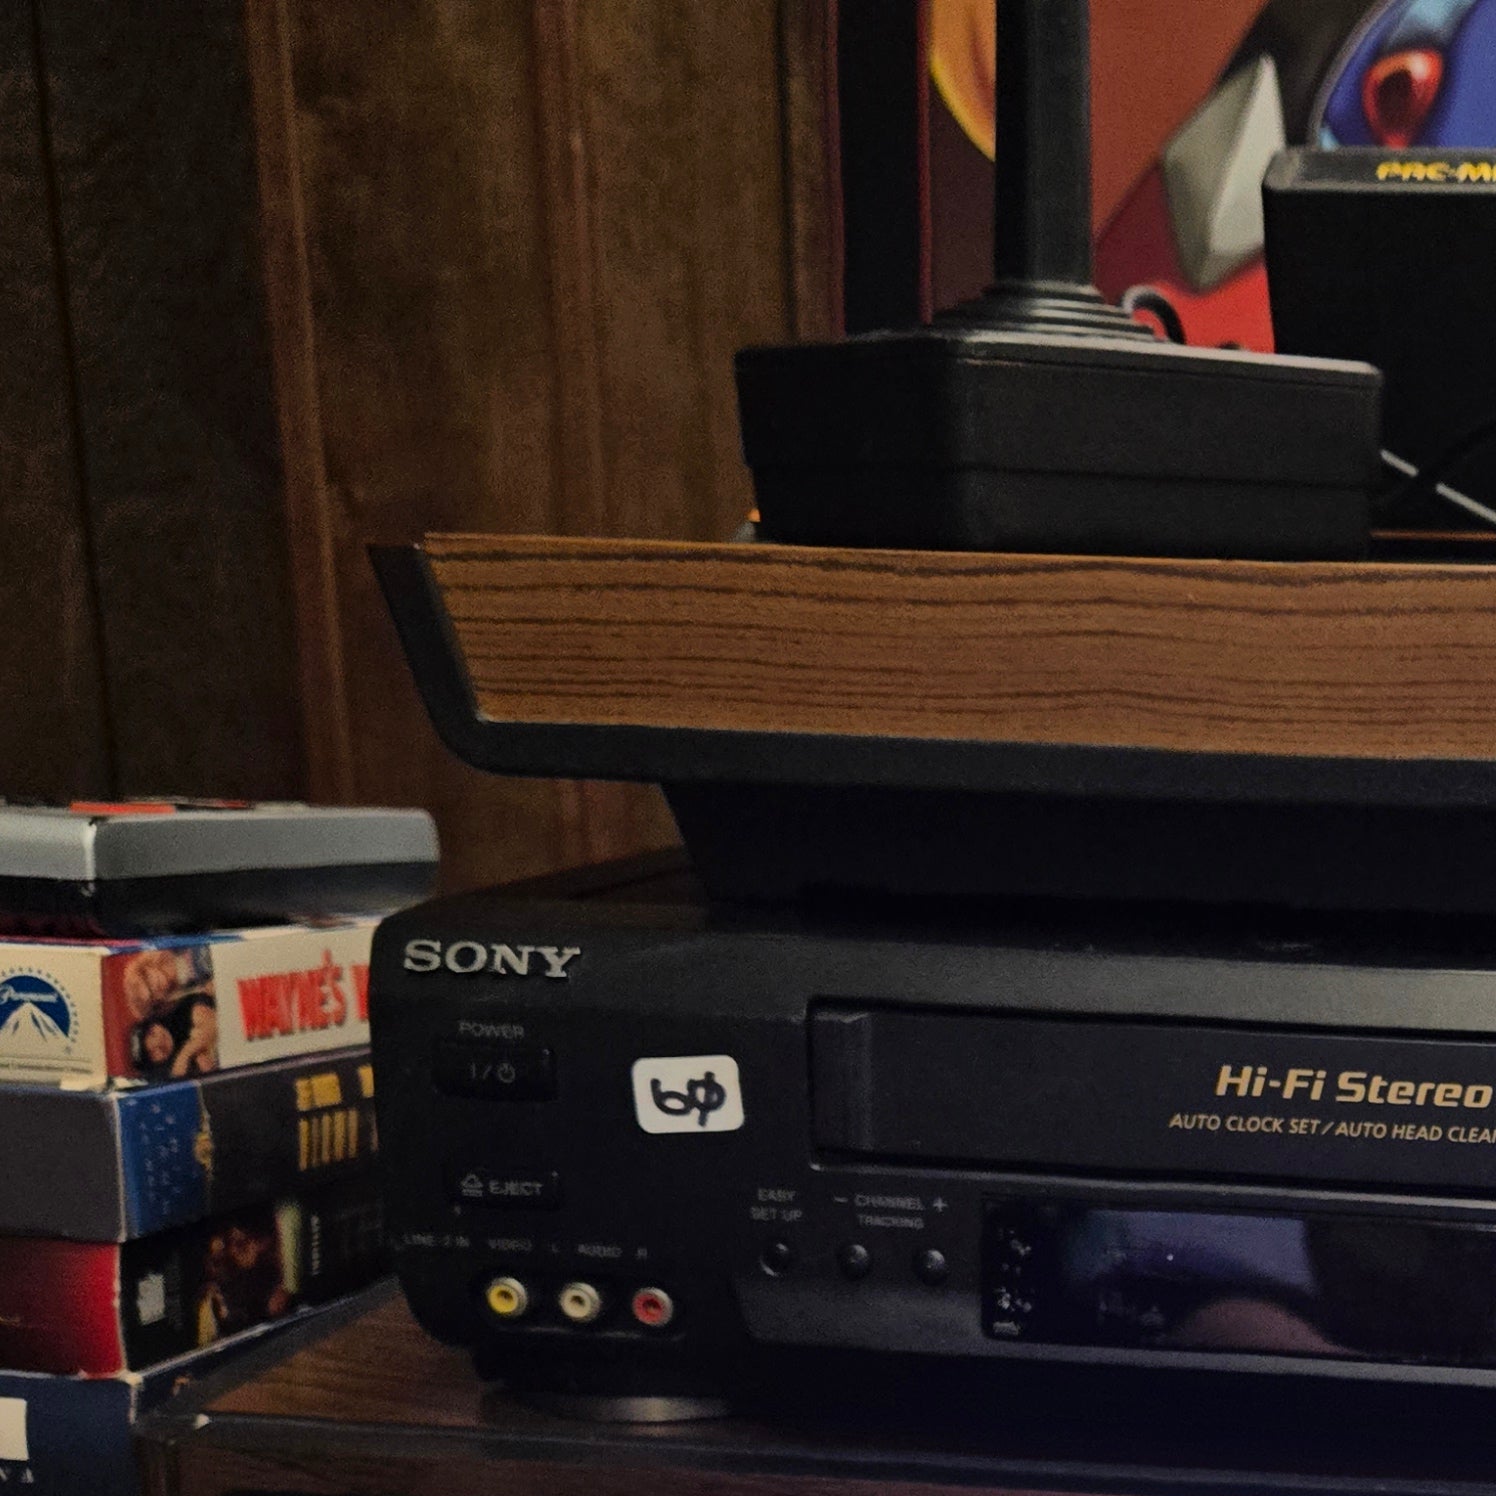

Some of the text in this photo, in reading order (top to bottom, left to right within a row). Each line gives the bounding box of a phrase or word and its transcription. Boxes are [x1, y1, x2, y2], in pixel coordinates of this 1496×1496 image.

[402, 939, 581, 978] SONY
[236, 948, 347, 1042] WAYNE'S
[1216, 1065, 1494, 1110] Hi-Fi Stereo
[1168, 1112, 1221, 1133] AUTO
[1225, 1115, 1285, 1135] CLOCK
[1390, 1123, 1443, 1142] HEAD
[489, 1179, 543, 1197] EJECT
